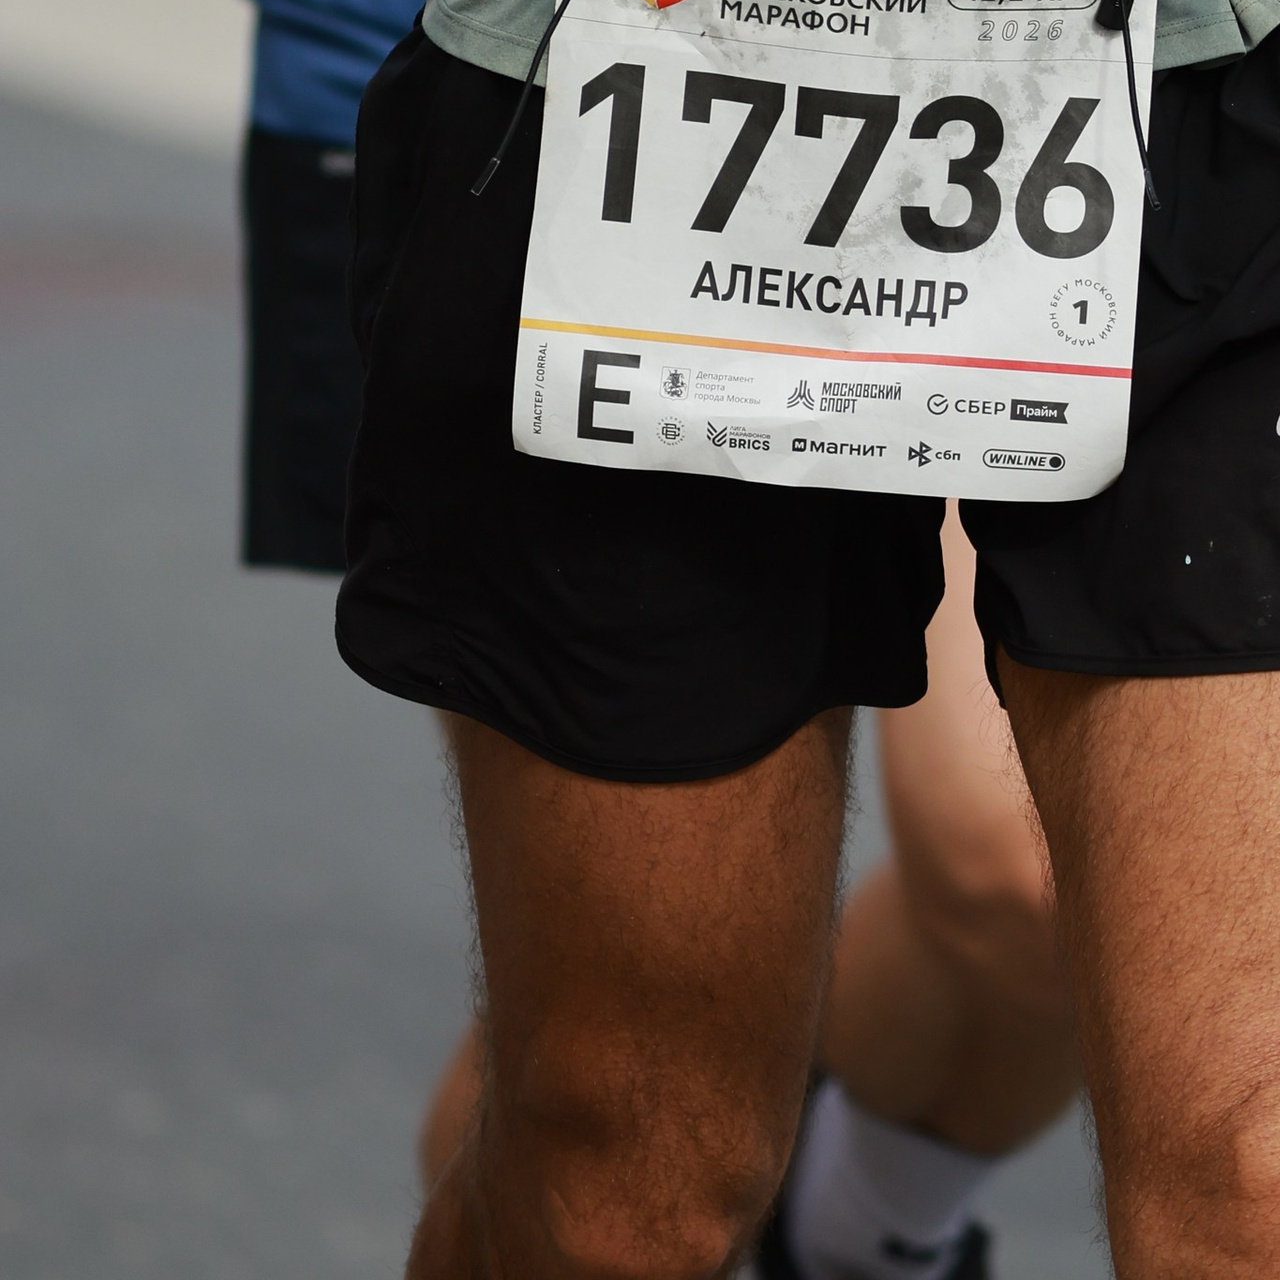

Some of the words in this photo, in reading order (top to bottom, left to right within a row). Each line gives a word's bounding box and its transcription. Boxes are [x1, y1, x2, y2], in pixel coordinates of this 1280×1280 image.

[720, 0, 870, 36] МАРАФОН
[977, 19, 1064, 41] 2026
[577, 61, 1115, 260] 17736
[690, 260, 969, 328] АЛЕКСАНДР
[1050, 283, 1069, 308] БЕГУ
[1072, 299, 1088, 325] 1
[1074, 279, 1118, 340] МОСКОВСКИЙ
[1049, 312, 1096, 347] МАРАФОН
[536, 342, 548, 382] CORRAL
[695, 382, 726, 392] спорта
[696, 370, 755, 384] Департамент
[577, 349, 641, 445] E
[694, 393, 725, 403] города
[727, 394, 761, 405] Москвы
[821, 381, 902, 401] МОСКОВСКИЙ
[533, 390, 543, 435] КЛАСТЕР
[819, 397, 858, 414] СПОРТ
[954, 398, 1006, 416] СБЕР
[1016, 404, 1058, 418] Прайм
[729, 438, 770, 451] BRICS
[809, 440, 887, 458] магнит
[935, 449, 961, 461] сбп
[988, 453, 1048, 467] WINLINE
